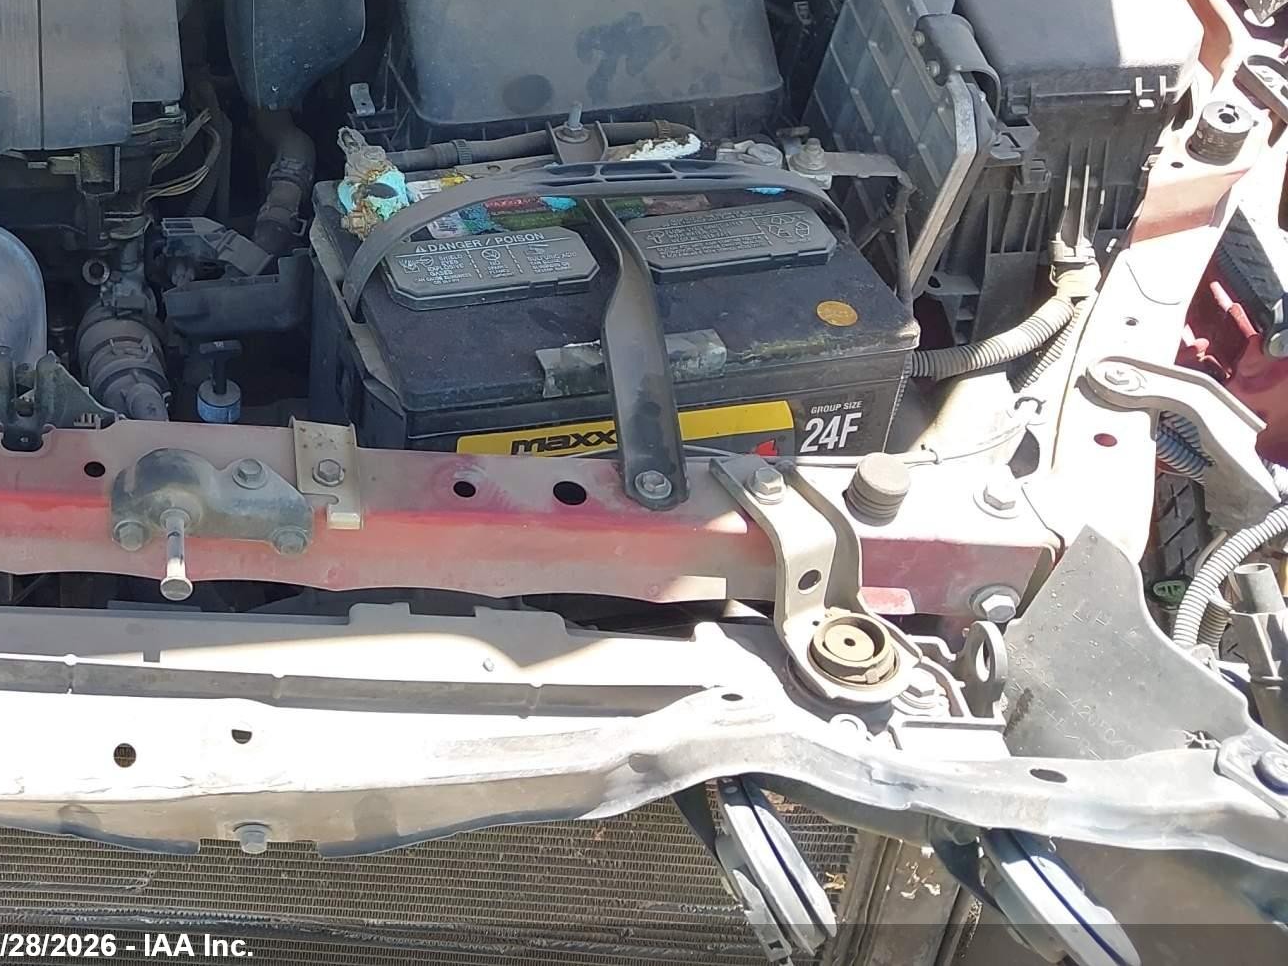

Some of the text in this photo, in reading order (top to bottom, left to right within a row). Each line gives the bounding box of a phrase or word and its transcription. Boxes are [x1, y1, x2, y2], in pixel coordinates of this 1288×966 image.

[427, 239, 483, 252] DANGER
[495, 233, 545, 245] POISON
[810, 400, 863, 415] GROUP SIZE
[799, 412, 863, 453] 24F
